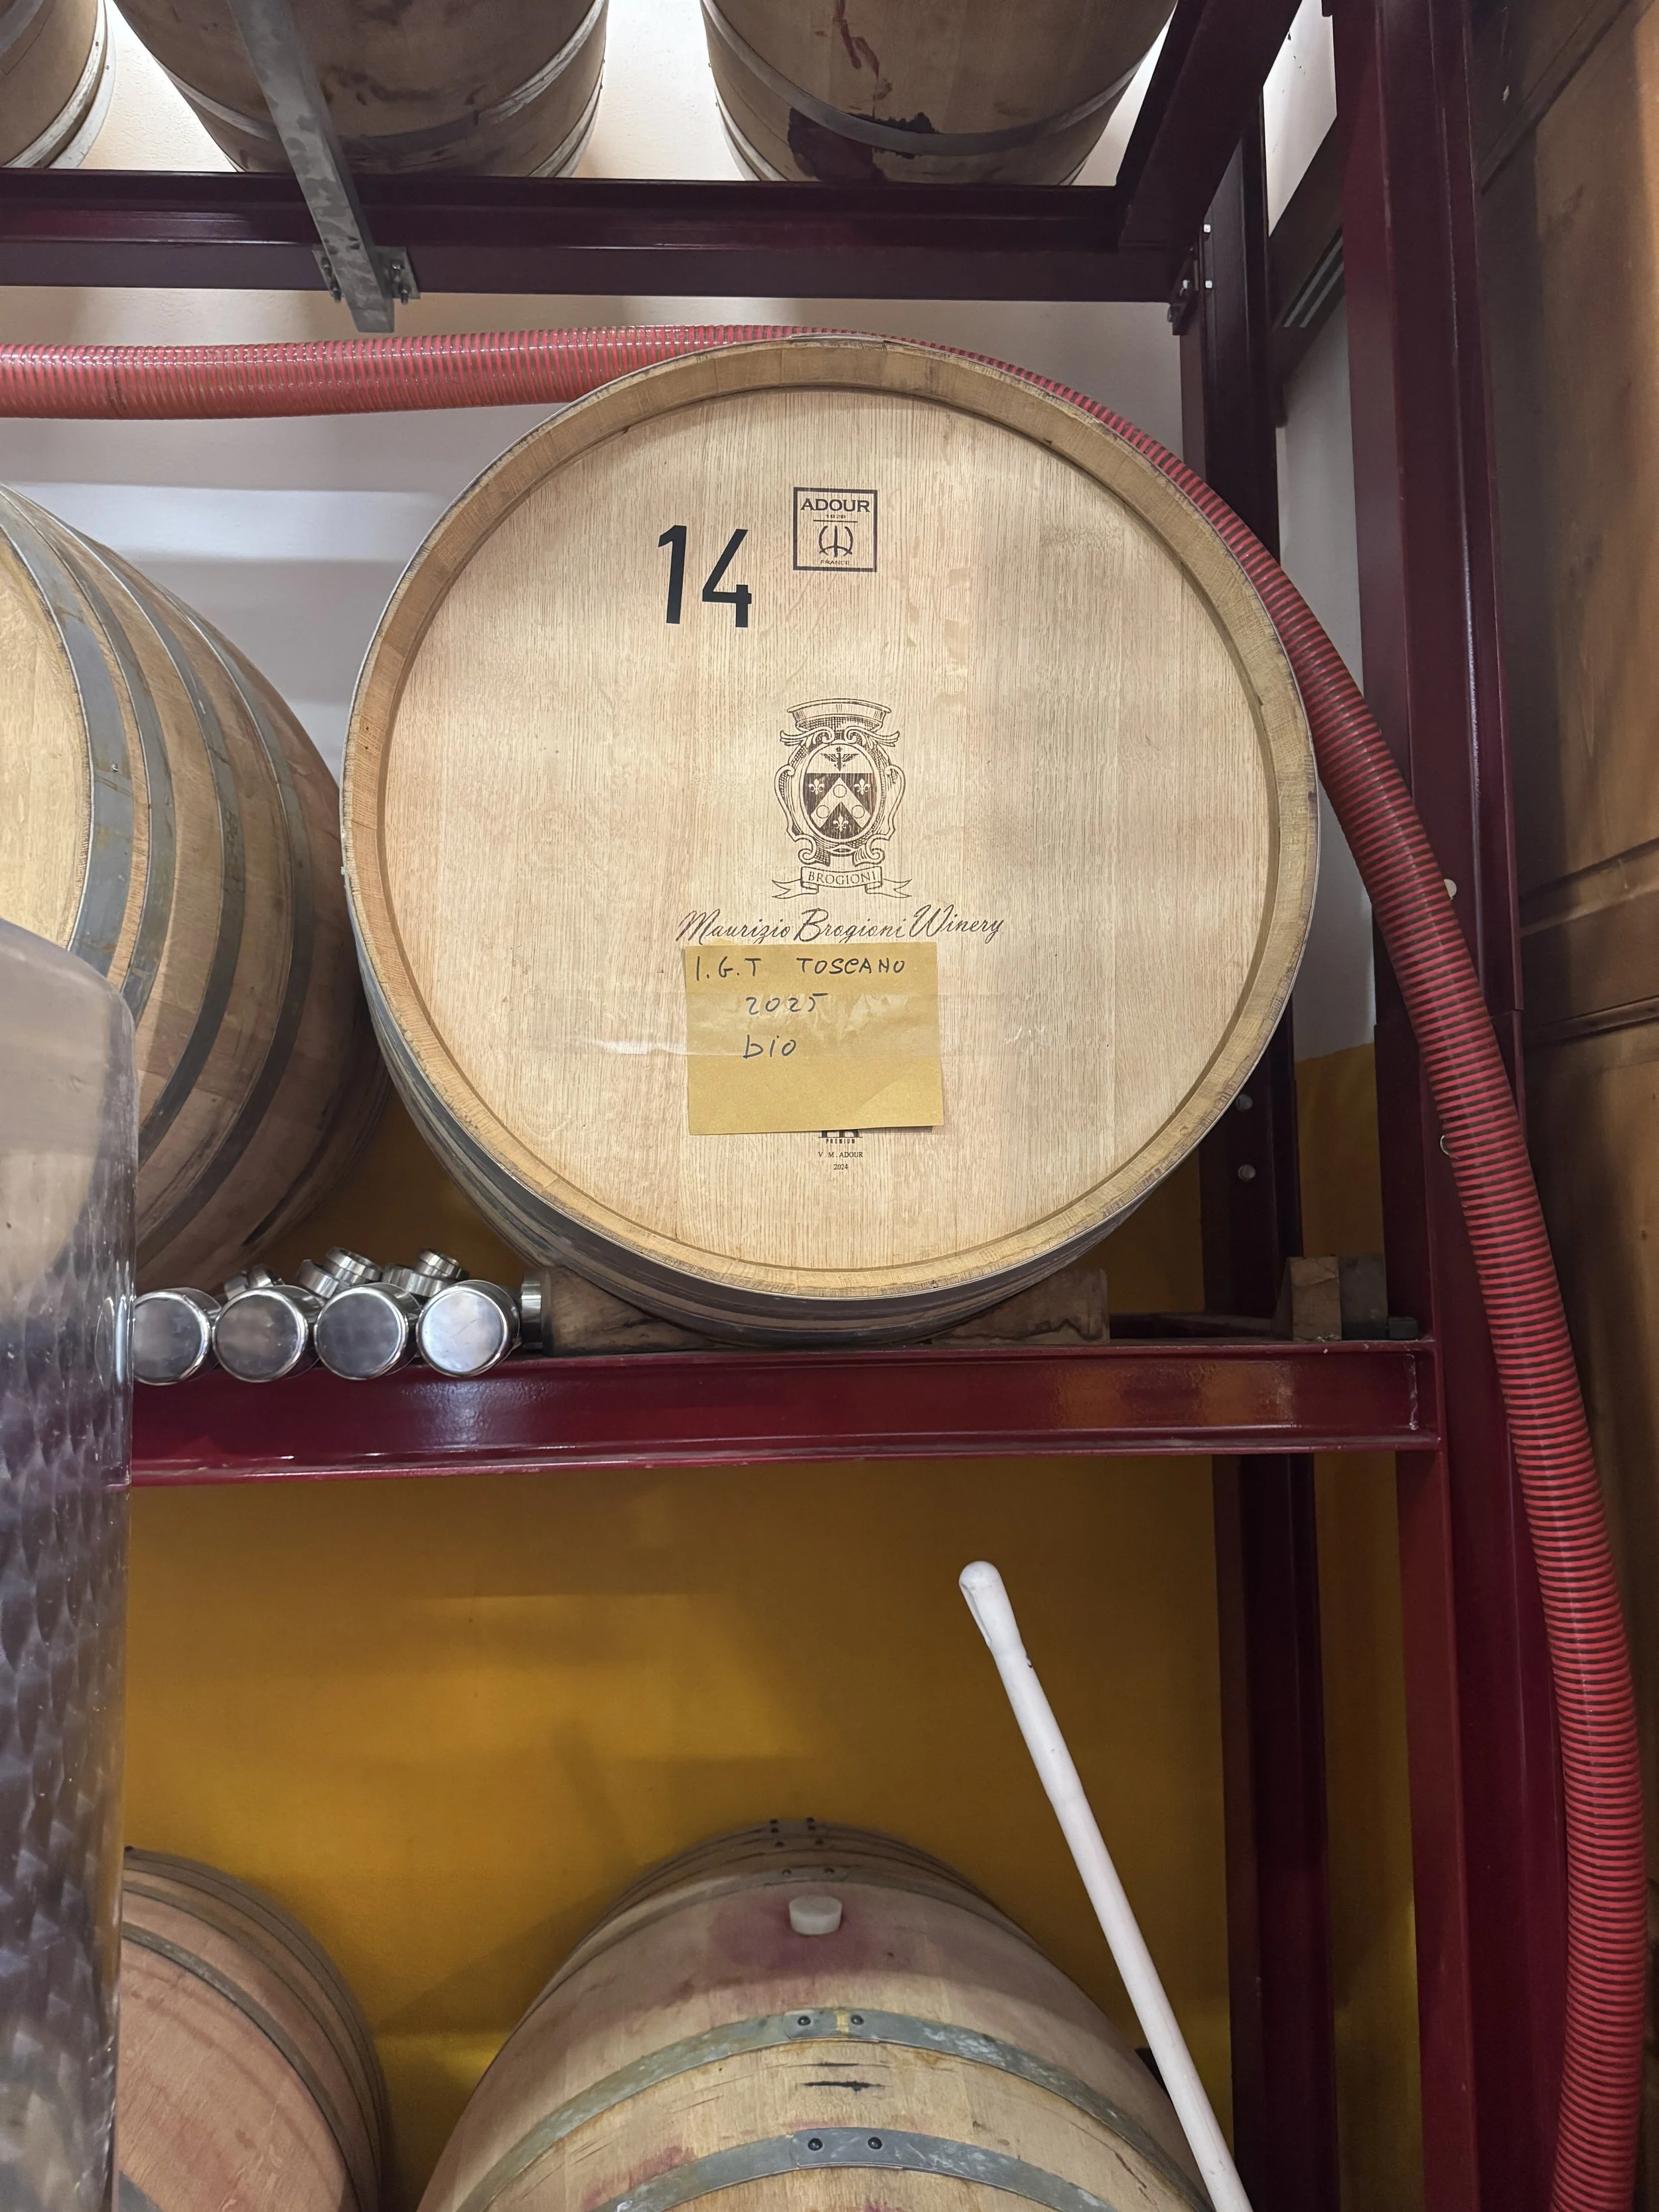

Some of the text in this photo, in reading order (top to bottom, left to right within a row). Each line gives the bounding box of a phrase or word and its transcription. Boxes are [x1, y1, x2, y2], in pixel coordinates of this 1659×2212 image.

[800, 498, 871, 513] ADOUR
[658, 524, 752, 628] 14
[808, 871, 877, 885] BROGIONI
[675, 904, 1005, 945] Maurizio Brogioni Winery
[796, 957, 906, 975] TOSCANO
[745, 992, 829, 1016] 2025
[743, 1034, 797, 1060] bio
